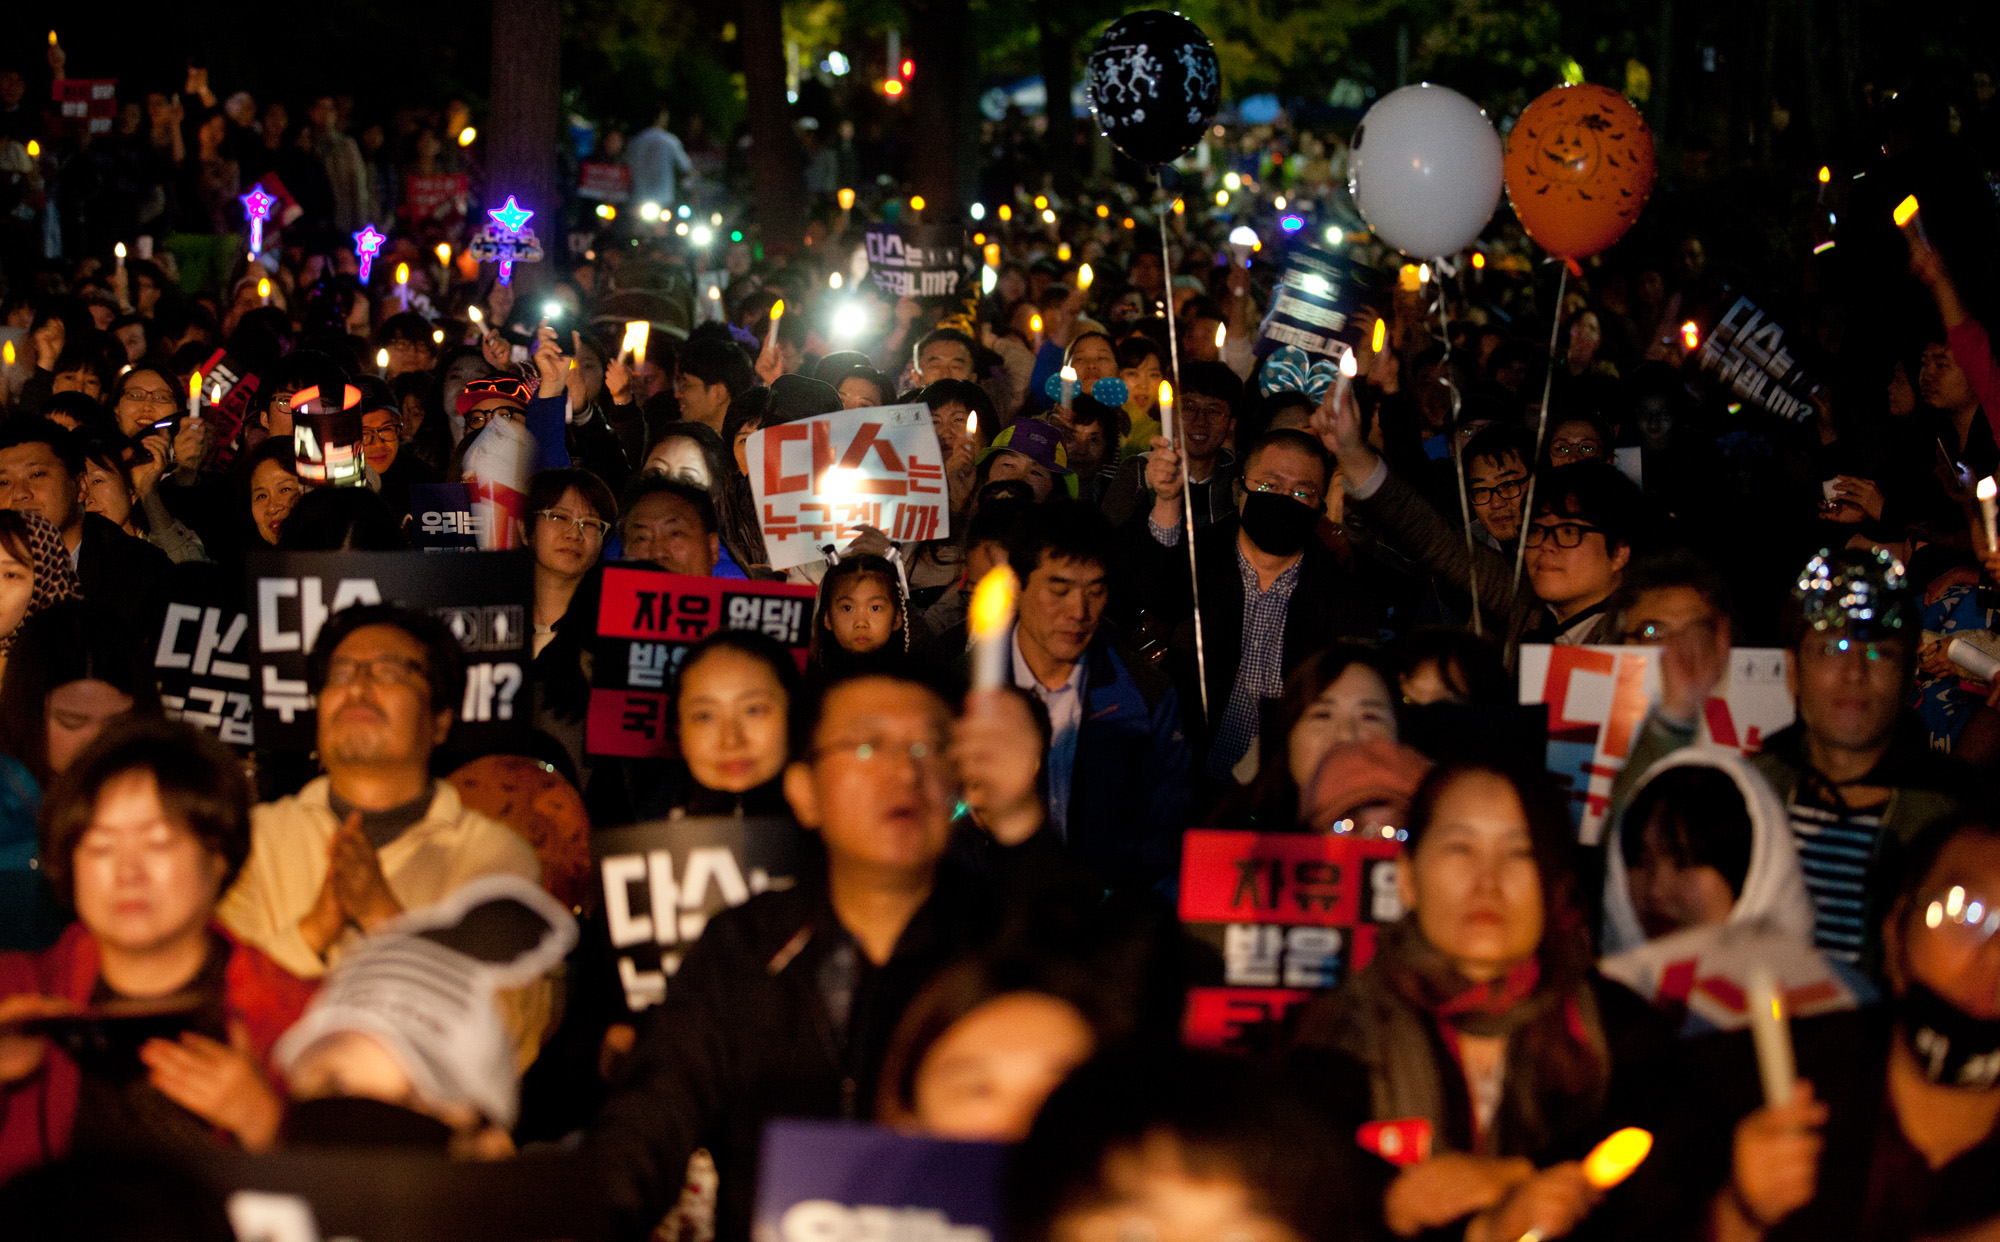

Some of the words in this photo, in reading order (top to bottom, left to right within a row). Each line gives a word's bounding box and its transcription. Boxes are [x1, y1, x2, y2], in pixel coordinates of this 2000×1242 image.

[865, 231, 923, 268] 다스는
[1706, 295, 1796, 381] 다스는
[763, 421, 942, 496] 다스는
[421, 511, 484, 535] 우리는
[763, 502, 940, 542] 누구겁니까
[632, 591, 711, 637] 자유
[1230, 857, 1343, 913] 자유
[1223, 922, 1344, 990] 받은
